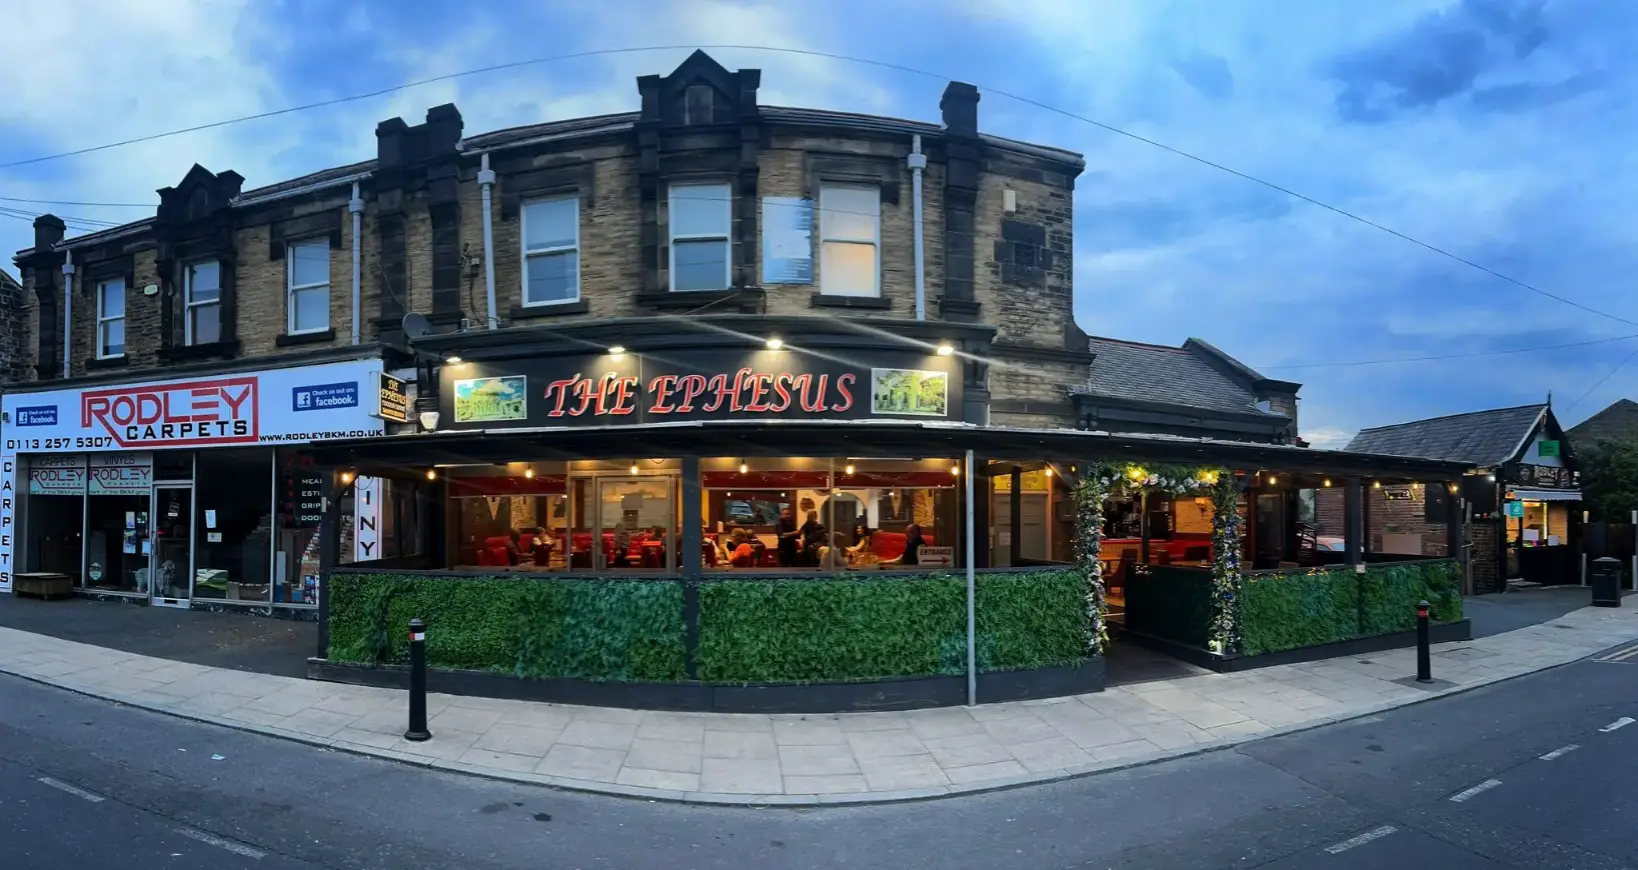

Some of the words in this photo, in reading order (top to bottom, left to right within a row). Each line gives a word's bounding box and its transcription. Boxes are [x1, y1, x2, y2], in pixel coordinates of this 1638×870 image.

[544, 372, 638, 417] THE
[649, 368, 856, 414] EPHESUS
[81, 385, 250, 428] RODLEY
[126, 420, 247, 440] CARPETS
[7, 439, 39, 449] 0113
[45, 438, 70, 448] 257
[76, 437, 112, 447] 5307
[104, 454, 135, 465] VINYLS
[31, 470, 84, 481] RODLEY
[90, 468, 150, 480] RODLEY
[0, 462, 12, 583] CARPETS
[360, 476, 376, 556] INY
